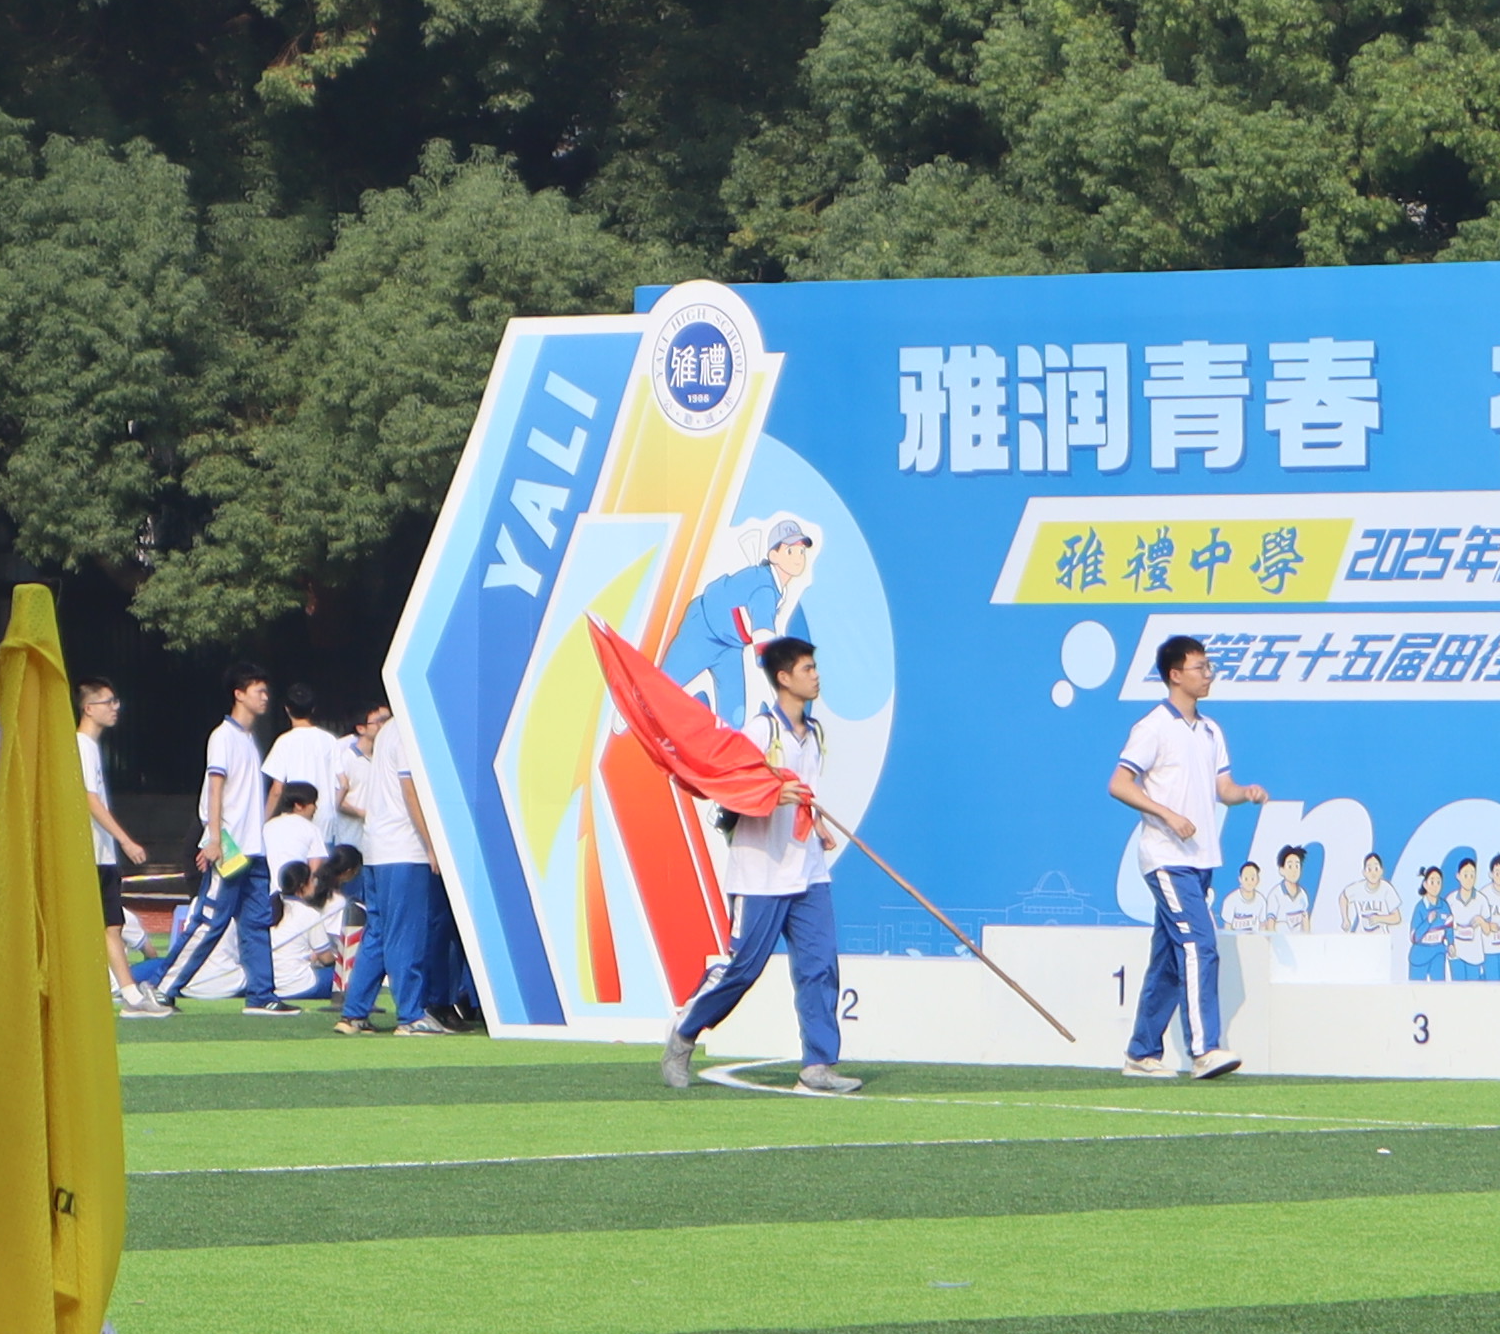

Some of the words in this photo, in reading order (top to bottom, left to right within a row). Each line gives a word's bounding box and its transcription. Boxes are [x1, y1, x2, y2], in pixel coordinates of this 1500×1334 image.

[670, 343, 727, 388] 雅禮
[671, 308, 706, 331] HIGH
[713, 313, 743, 379] SCHOOL
[899, 337, 1382, 475] 雅润青春
[483, 371, 598, 597] YALI
[841, 989, 859, 1021] 2
[1112, 965, 1125, 1006] 1
[1413, 1014, 1430, 1044] 3
